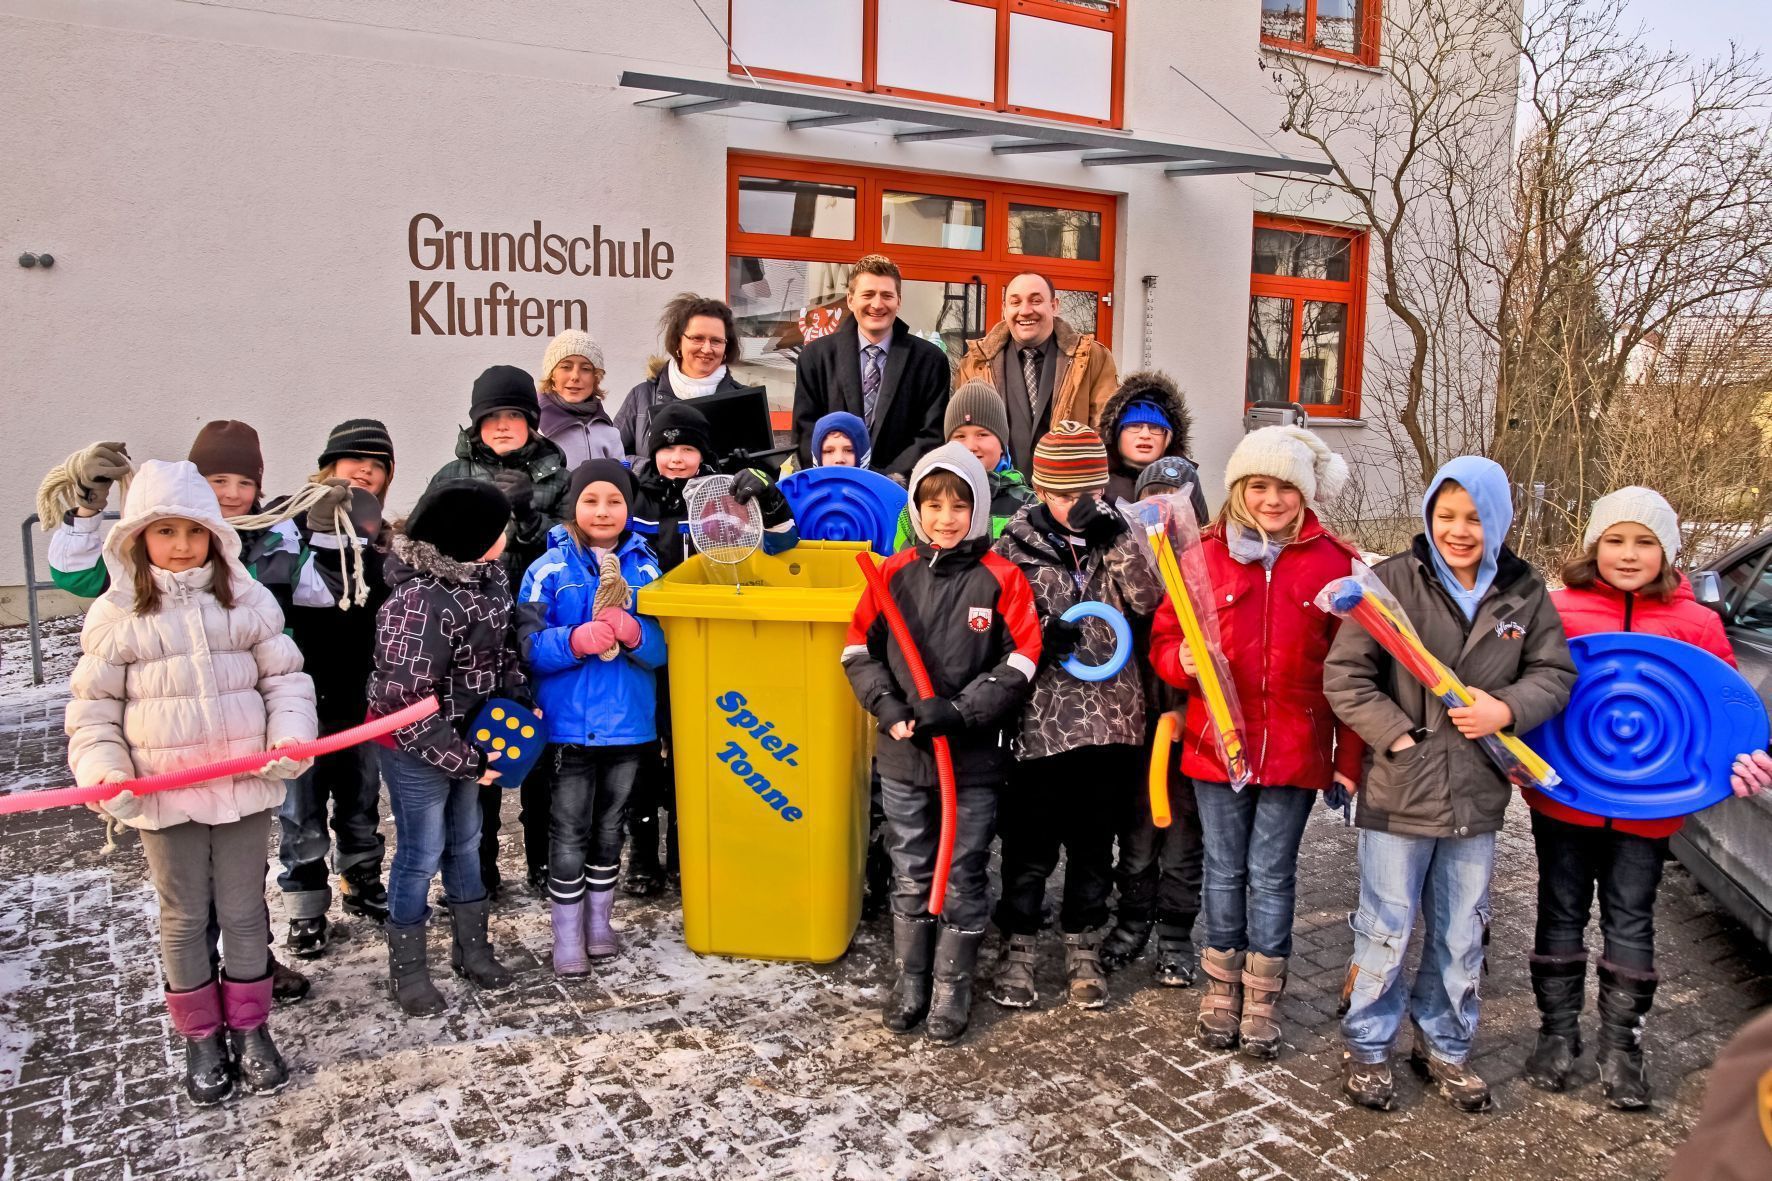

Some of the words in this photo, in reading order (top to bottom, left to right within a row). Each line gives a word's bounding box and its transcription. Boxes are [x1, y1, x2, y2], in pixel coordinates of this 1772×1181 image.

[408, 212, 675, 280] Grundschule
[408, 280, 588, 337] Kluftern
[715, 690, 799, 767] Spiel-
[715, 741, 803, 822] Tonne
